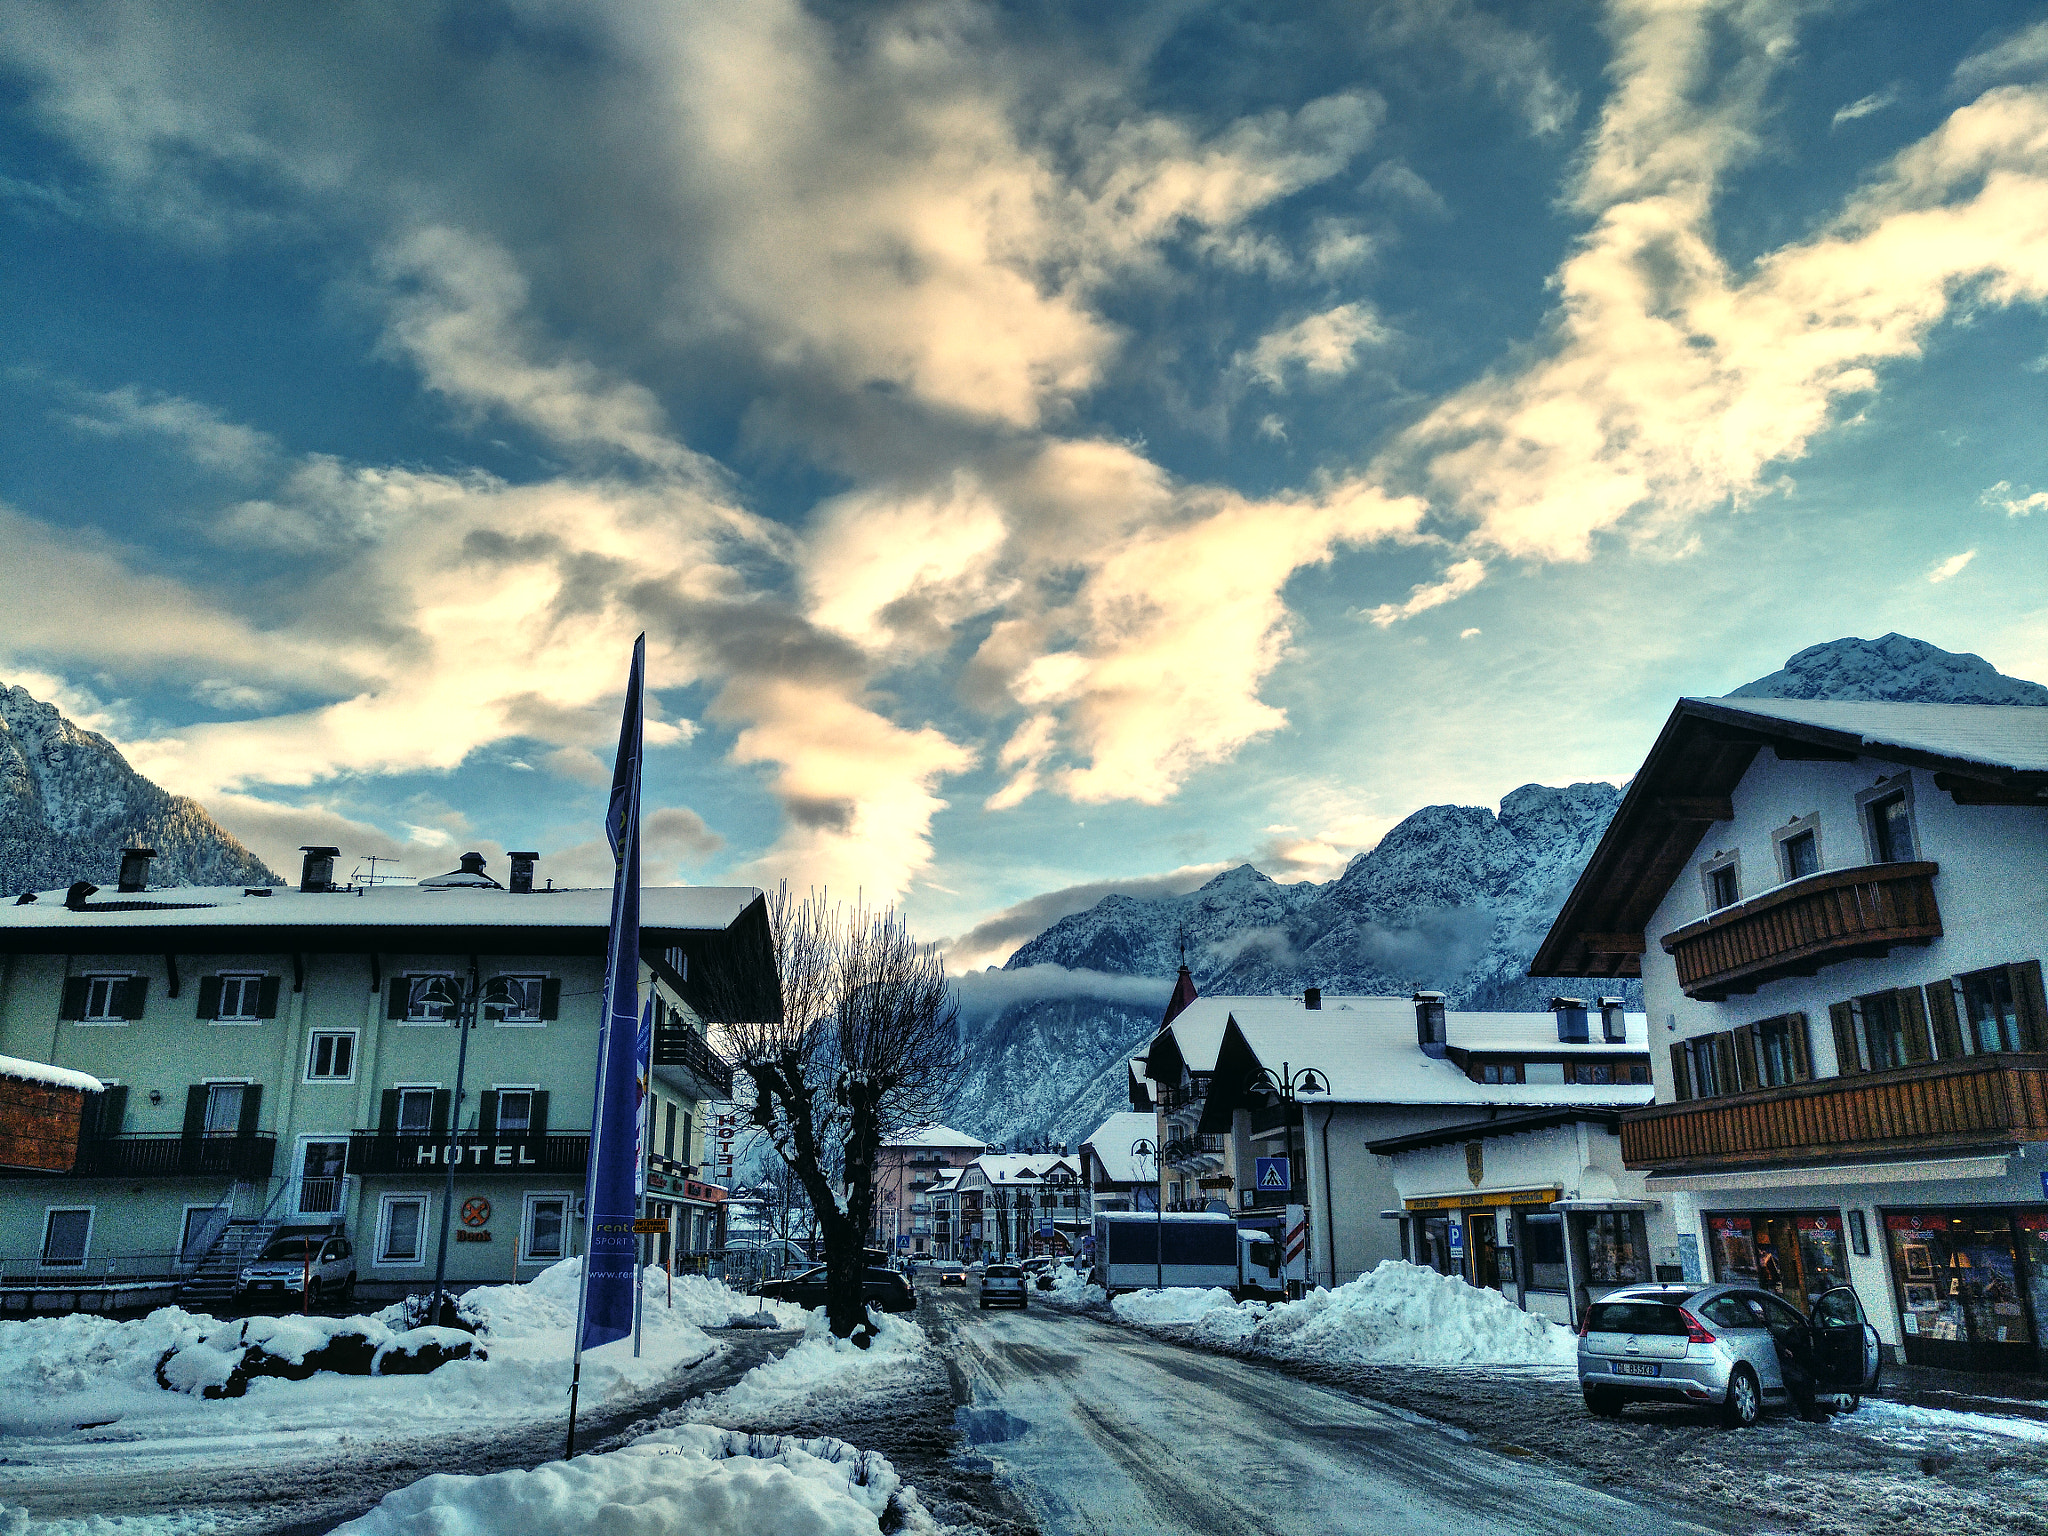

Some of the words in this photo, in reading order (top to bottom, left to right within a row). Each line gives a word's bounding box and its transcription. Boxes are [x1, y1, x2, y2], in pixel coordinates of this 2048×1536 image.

[416, 1145, 536, 1165] HOTEL
[596, 1223, 629, 1233] rent
[595, 1237, 629, 1246] SPORT
[1452, 1228, 1460, 1245] P
